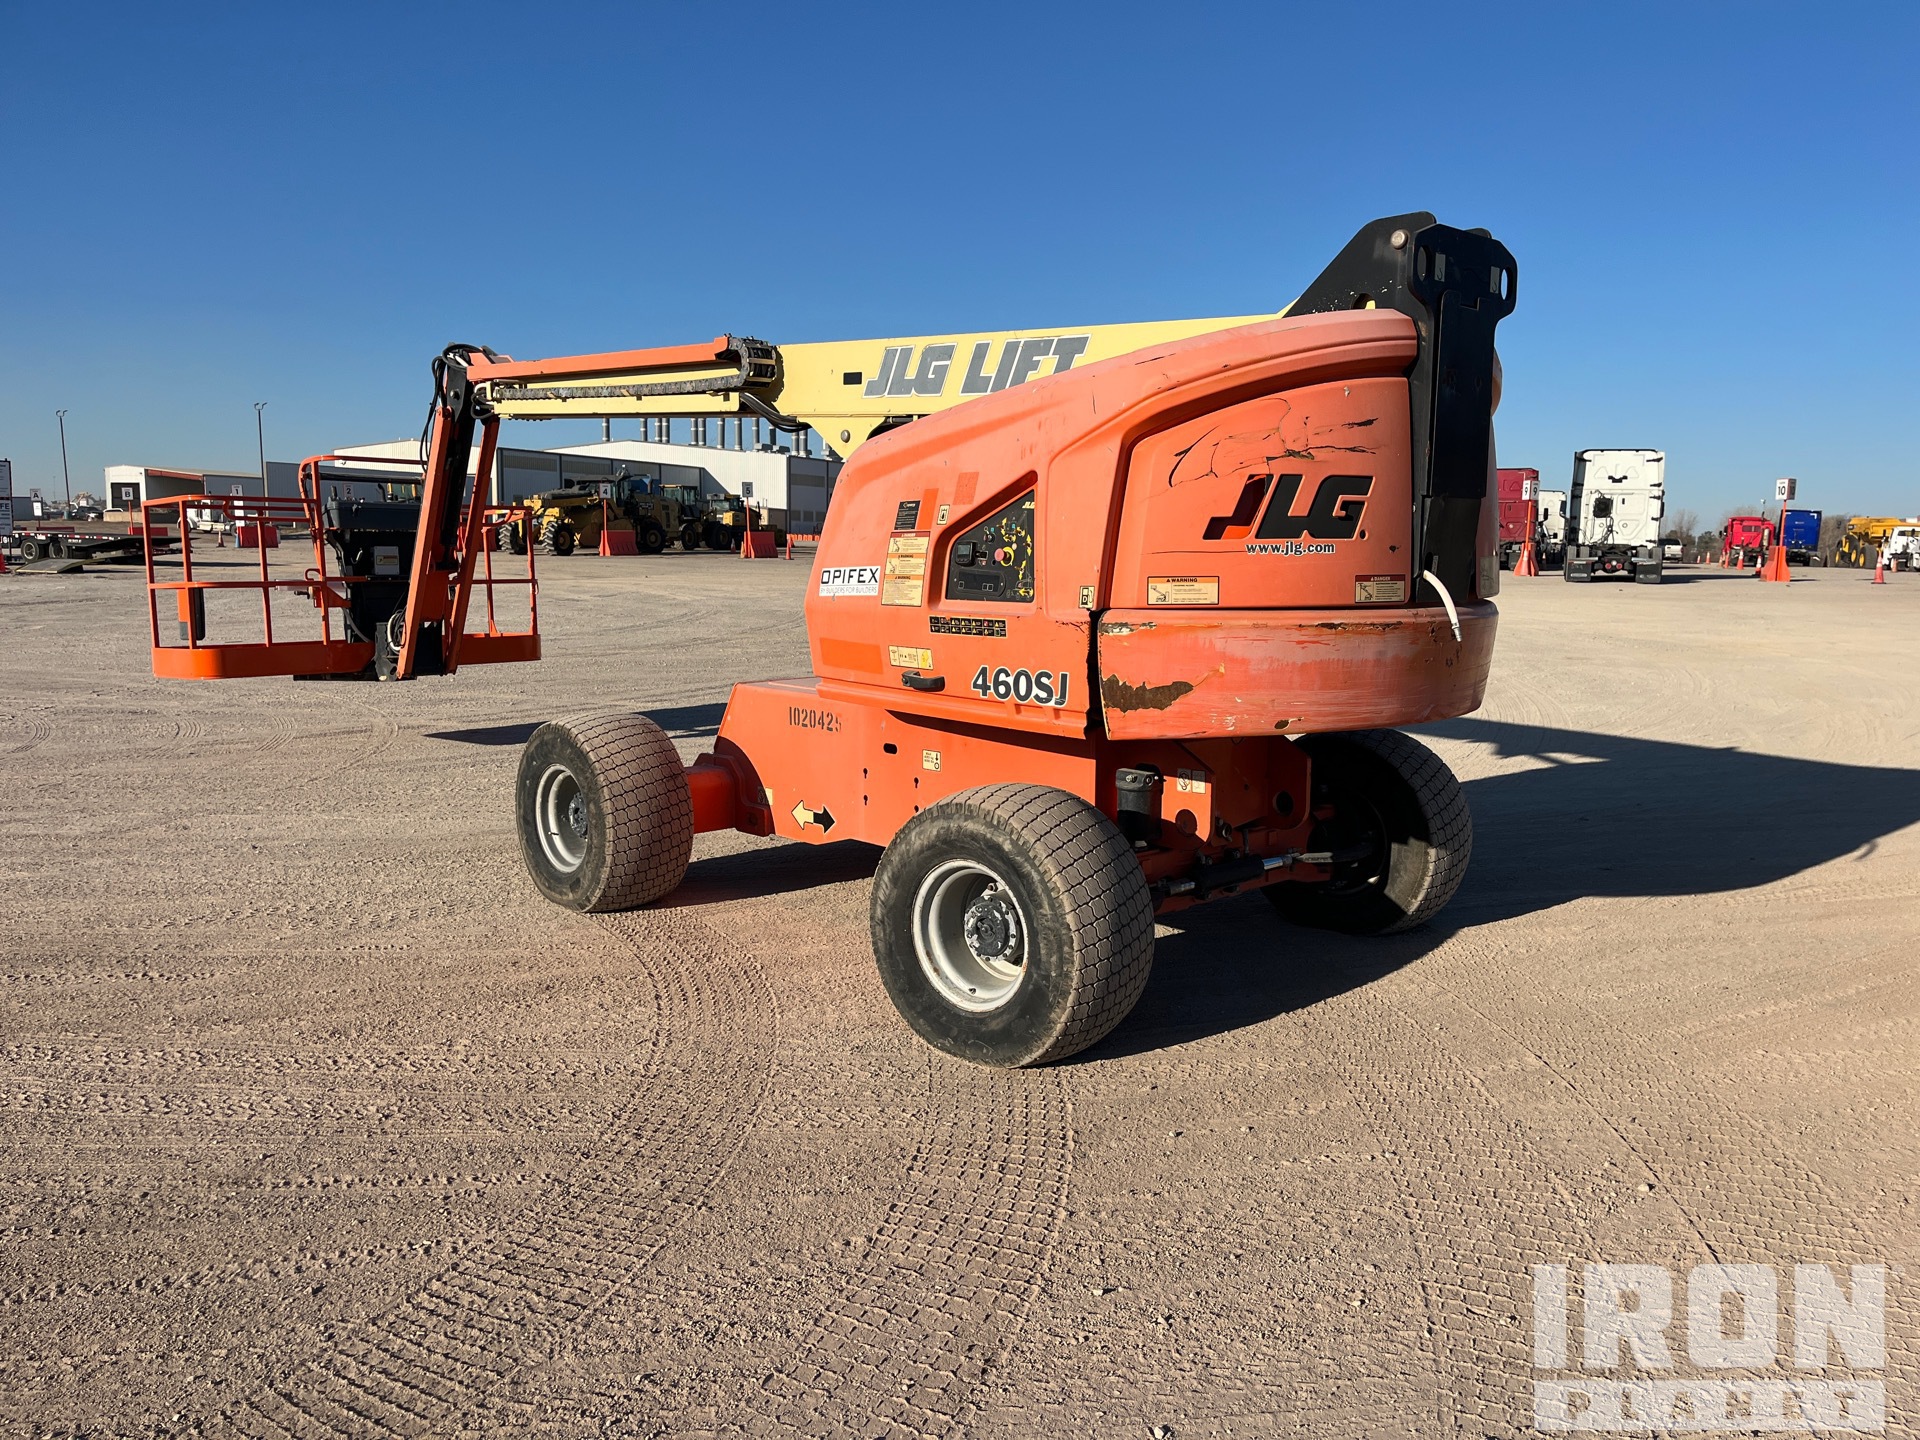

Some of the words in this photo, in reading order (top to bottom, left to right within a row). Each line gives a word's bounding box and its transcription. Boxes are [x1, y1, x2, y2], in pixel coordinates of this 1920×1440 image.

[863, 343, 957, 398] JLG
[960, 334, 1091, 395] LIFT
[746, 487, 751, 495] 5
[1525, 486, 1529, 496] 9
[1533, 486, 1538, 496] 9
[1778, 486, 1786, 495] 10
[1202, 473, 1374, 540] JLG
[1246, 541, 1335, 556] www.jlg.com
[821, 568, 879, 584] OPIFEX
[972, 666, 1068, 706] 460SJ
